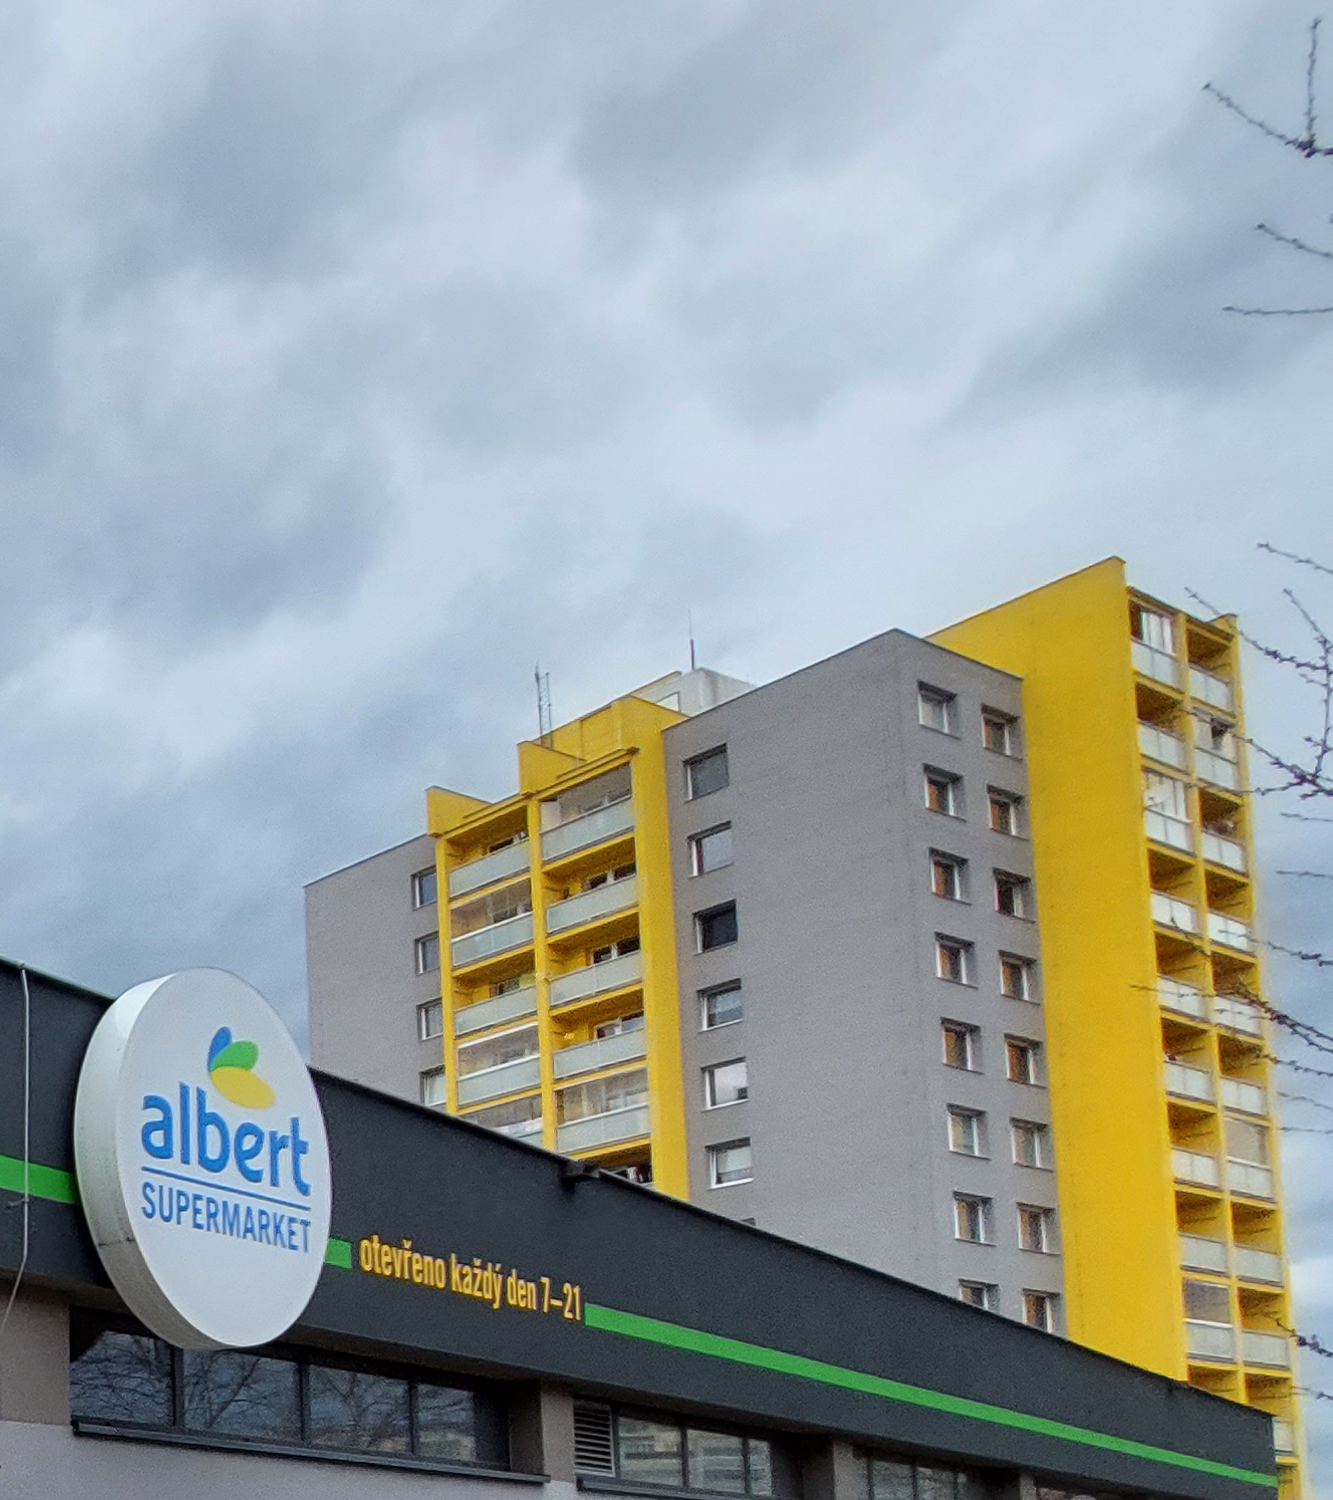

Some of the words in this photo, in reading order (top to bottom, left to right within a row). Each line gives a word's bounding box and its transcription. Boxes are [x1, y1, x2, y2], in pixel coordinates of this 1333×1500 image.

[141, 1081, 311, 1196] albert
[141, 1181, 311, 1253] SUPERMARKET
[358, 1234, 446, 1289] otevřeno
[450, 1253, 503, 1310] každý
[506, 1268, 537, 1311] den
